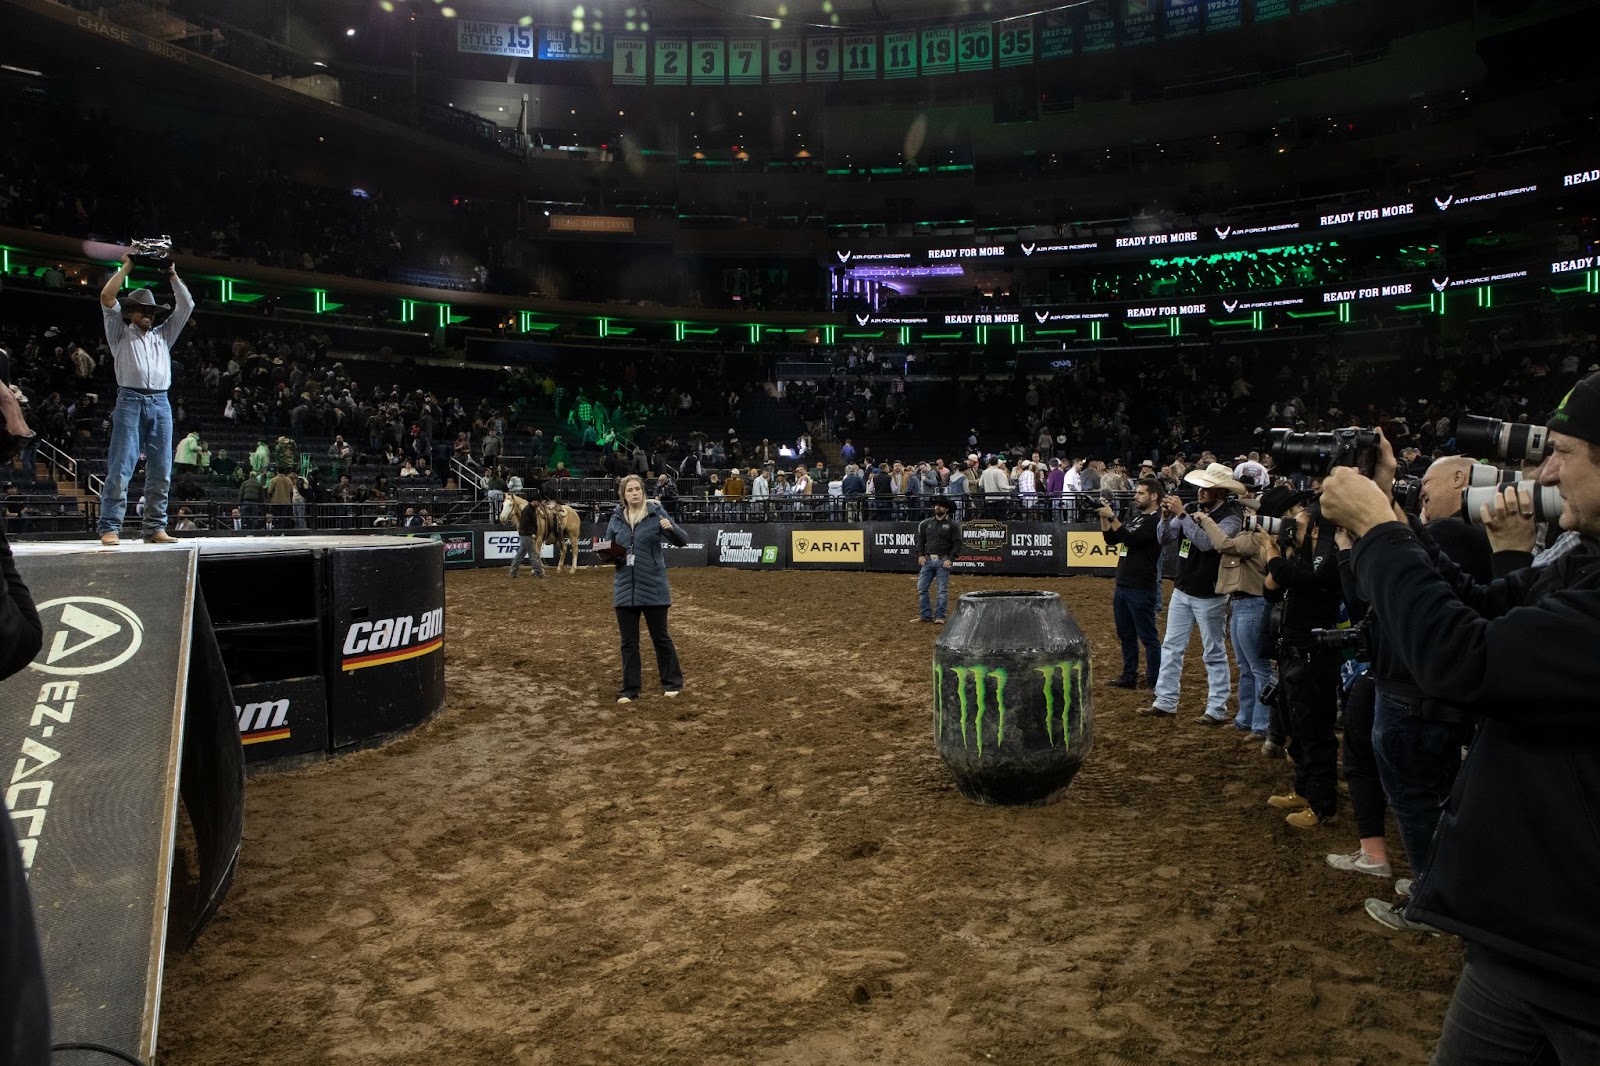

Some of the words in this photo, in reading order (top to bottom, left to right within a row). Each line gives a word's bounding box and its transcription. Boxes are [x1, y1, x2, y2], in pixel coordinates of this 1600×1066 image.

[464, 22, 500, 36] HARRY
[508, 26, 530, 48] 15
[546, 30, 565, 41] BILLY
[78, 16, 130, 43] CHASE
[148, 40, 189, 64] BRIDGE
[461, 34, 502, 46] STYLES
[547, 42, 565, 52] JOEL
[568, 32, 604, 54] 150
[962, 34, 989, 60] 30
[1002, 30, 1030, 54] 35
[816, 48, 829, 70] 9
[850, 46, 870, 69] 11
[891, 44, 911, 68] 11
[926, 39, 950, 63] 19
[625, 52, 634, 73] 1
[664, 52, 678, 73] 2
[702, 52, 714, 73] 3
[738, 52, 752, 73] 7
[779, 50, 792, 72] 9
[1469, 193, 1497, 202] FORCE
[1497, 185, 1537, 196] RESERVE
[1320, 212, 1355, 225] READY
[1357, 209, 1379, 221] FOR
[1382, 204, 1414, 217] MORE
[1268, 223, 1299, 231] RESERVE
[1116, 236, 1147, 247] READY
[1149, 235, 1168, 244] FOR
[1170, 232, 1197, 242] MORE
[928, 249, 958, 258] READY
[959, 248, 977, 257] FOR
[979, 246, 1005, 256] MORE
[1552, 257, 1593, 273] READY
[1491, 271, 1527, 280] RESERVE
[1323, 290, 1357, 302] READY
[1359, 288, 1379, 299] FOR
[1382, 284, 1412, 296] MORE
[945, 315, 973, 324] READY
[975, 315, 992, 323] FOR
[994, 314, 1019, 323] MORE
[1127, 307, 1157, 317] READY
[1159, 307, 1177, 315] FOR
[1179, 304, 1206, 314] MORE
[488, 536, 520, 544] COO
[716, 530, 752, 547] Farming
[875, 534, 894, 545] LET'S
[896, 533, 915, 546] ROCK
[963, 530, 981, 538] WORLD
[1011, 534, 1032, 546] LET'S
[1034, 534, 1052, 546] RIDE
[720, 546, 762, 563] Simulator
[765, 548, 775, 560] 25
[810, 542, 860, 552] ARIAT
[342, 606, 443, 656] can-am
